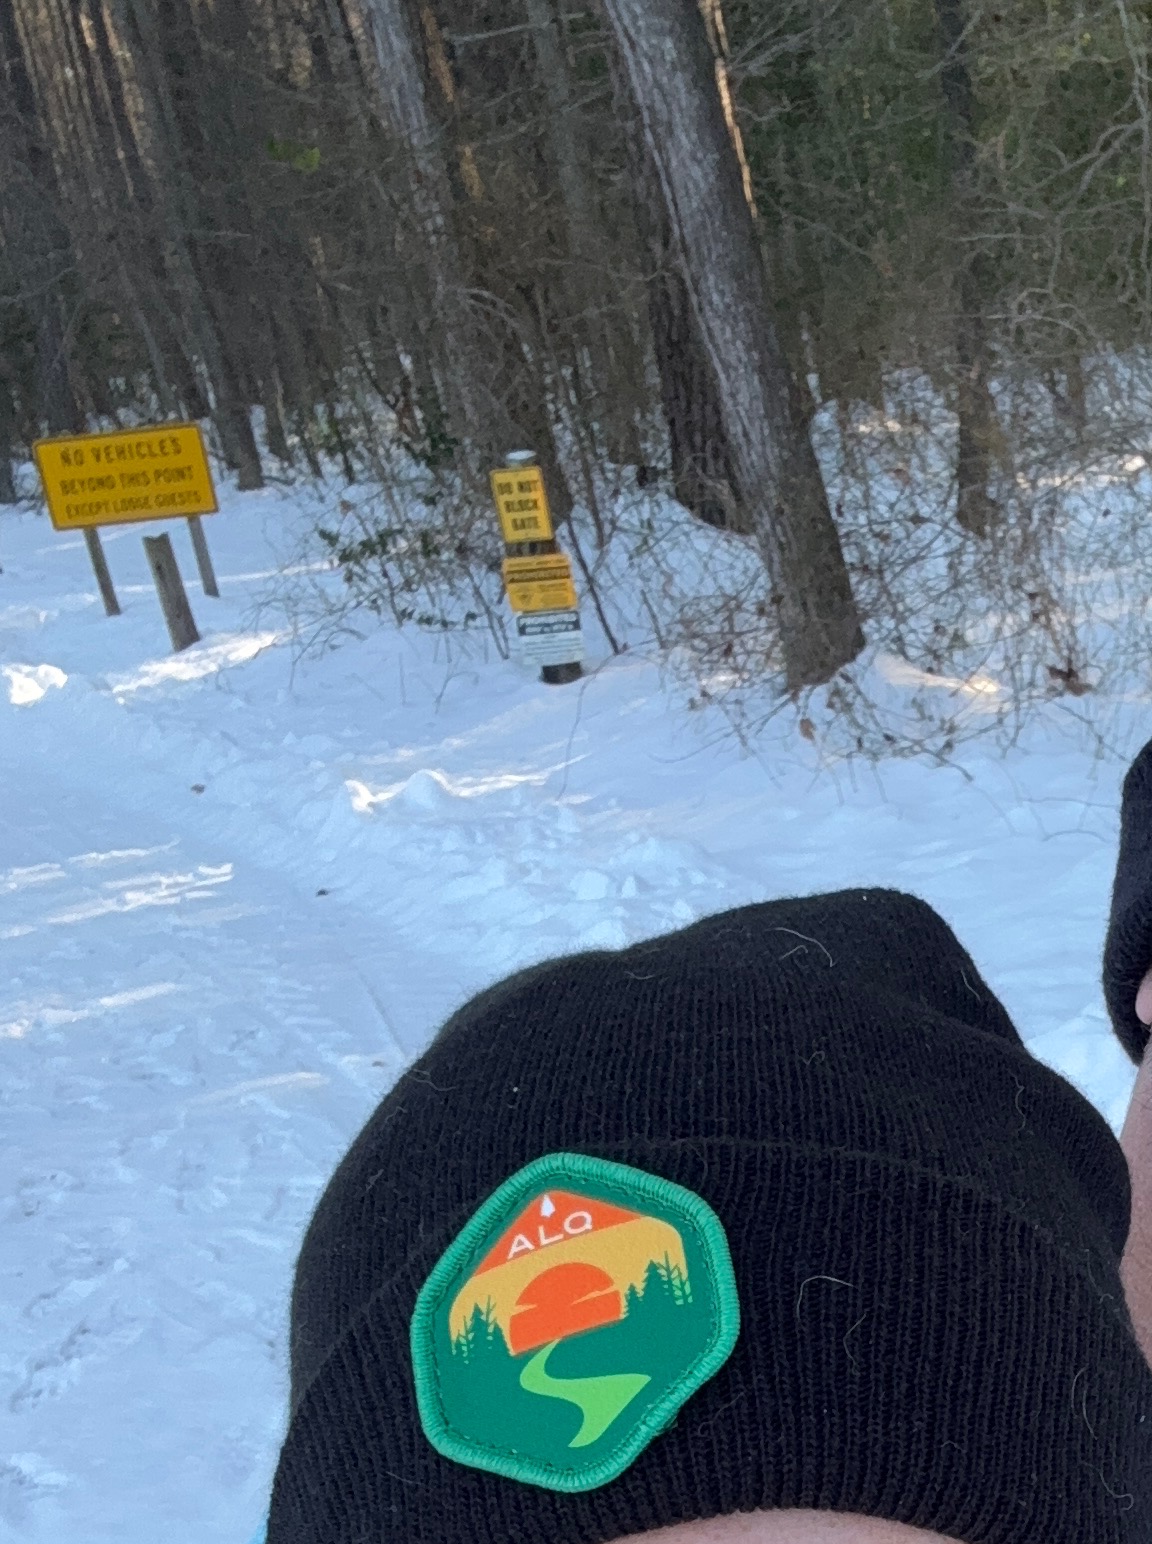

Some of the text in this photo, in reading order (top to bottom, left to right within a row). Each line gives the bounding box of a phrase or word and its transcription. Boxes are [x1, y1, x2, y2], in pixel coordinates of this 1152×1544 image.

[59, 436, 182, 467] NO VEHICLES
[59, 465, 195, 497] BEYOND THIS POINT
